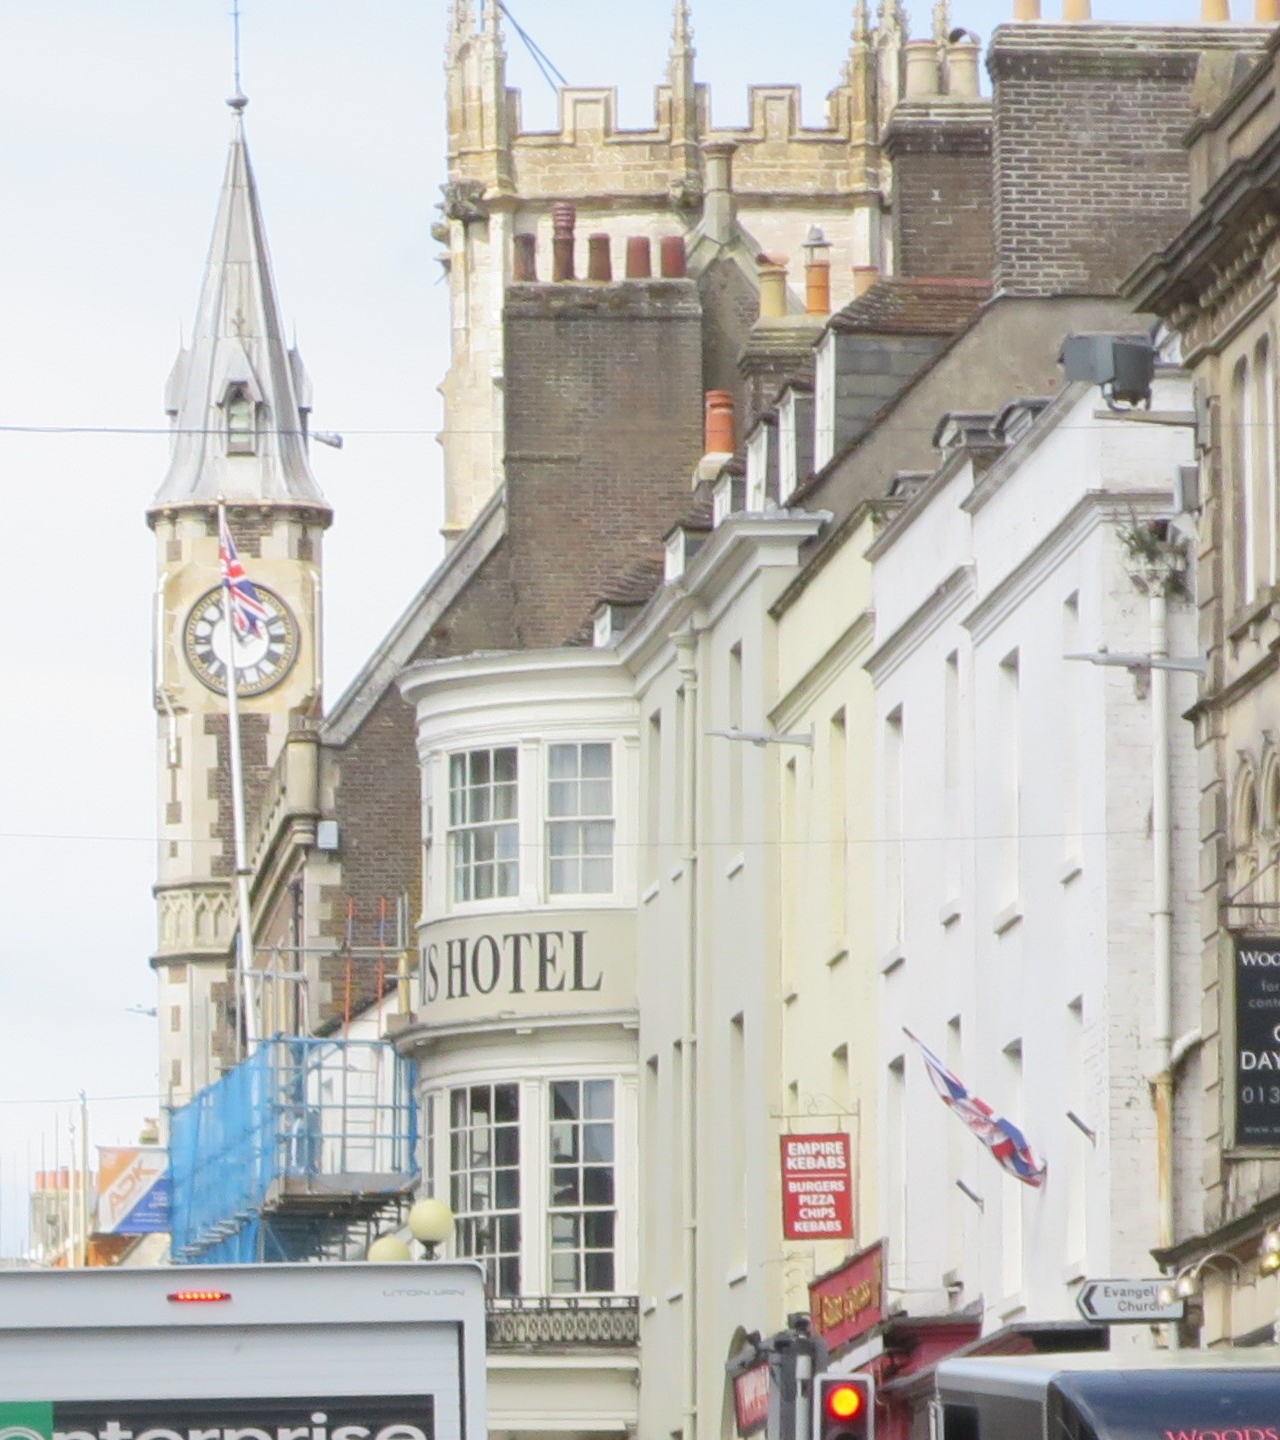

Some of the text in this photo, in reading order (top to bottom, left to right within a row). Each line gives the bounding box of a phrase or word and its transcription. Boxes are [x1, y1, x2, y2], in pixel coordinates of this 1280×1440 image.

[445, 930, 604, 1000] HOTEL
[788, 1141, 844, 1156] EMPIRE
[787, 1156, 847, 1170] KEBABS
[789, 1180, 845, 1192] BURGERS
[799, 1194, 836, 1206] PIZZA
[799, 1207, 837, 1219] CHIPS
[794, 1220, 843, 1232] KEBABS
